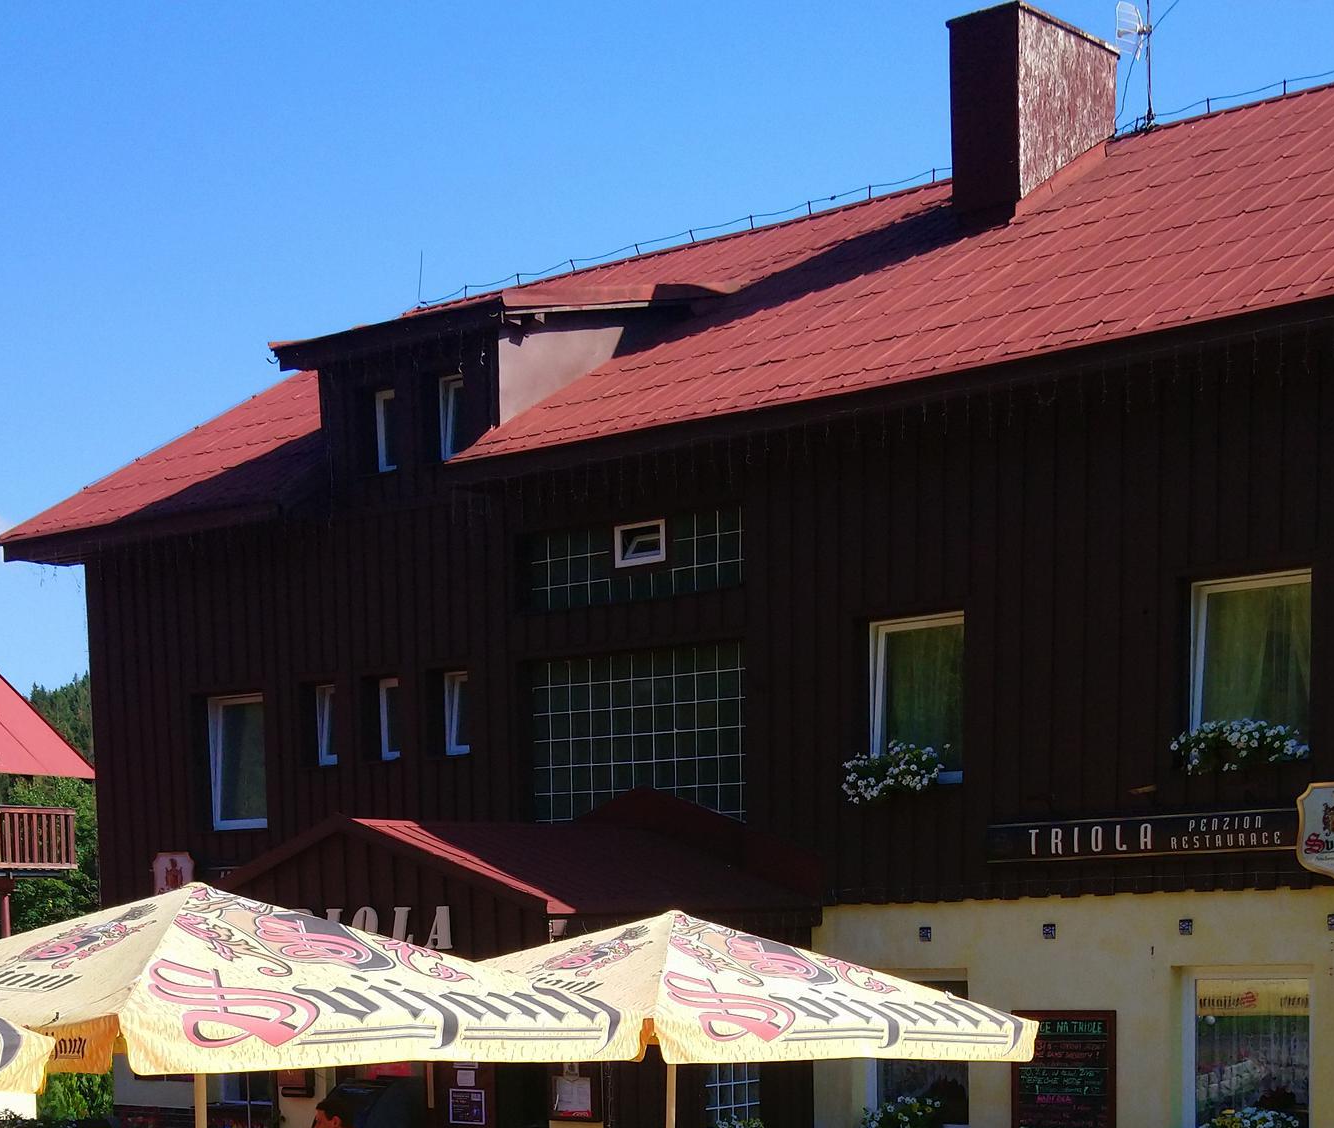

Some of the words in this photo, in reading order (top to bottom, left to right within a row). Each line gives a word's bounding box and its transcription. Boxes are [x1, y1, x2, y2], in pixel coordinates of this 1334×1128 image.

[1188, 815, 1263, 832] PENZION
[1028, 823, 1154, 856] TRIOLA
[1170, 831, 1283, 851] RESTAURACE
[148, 958, 621, 1055] Svijany
[663, 970, 1024, 1057] Svijany
[1039, 1021, 1052, 1033] CE
[1056, 1021, 1069, 1033] NA
[1071, 1021, 1103, 1034] TRIOLE
